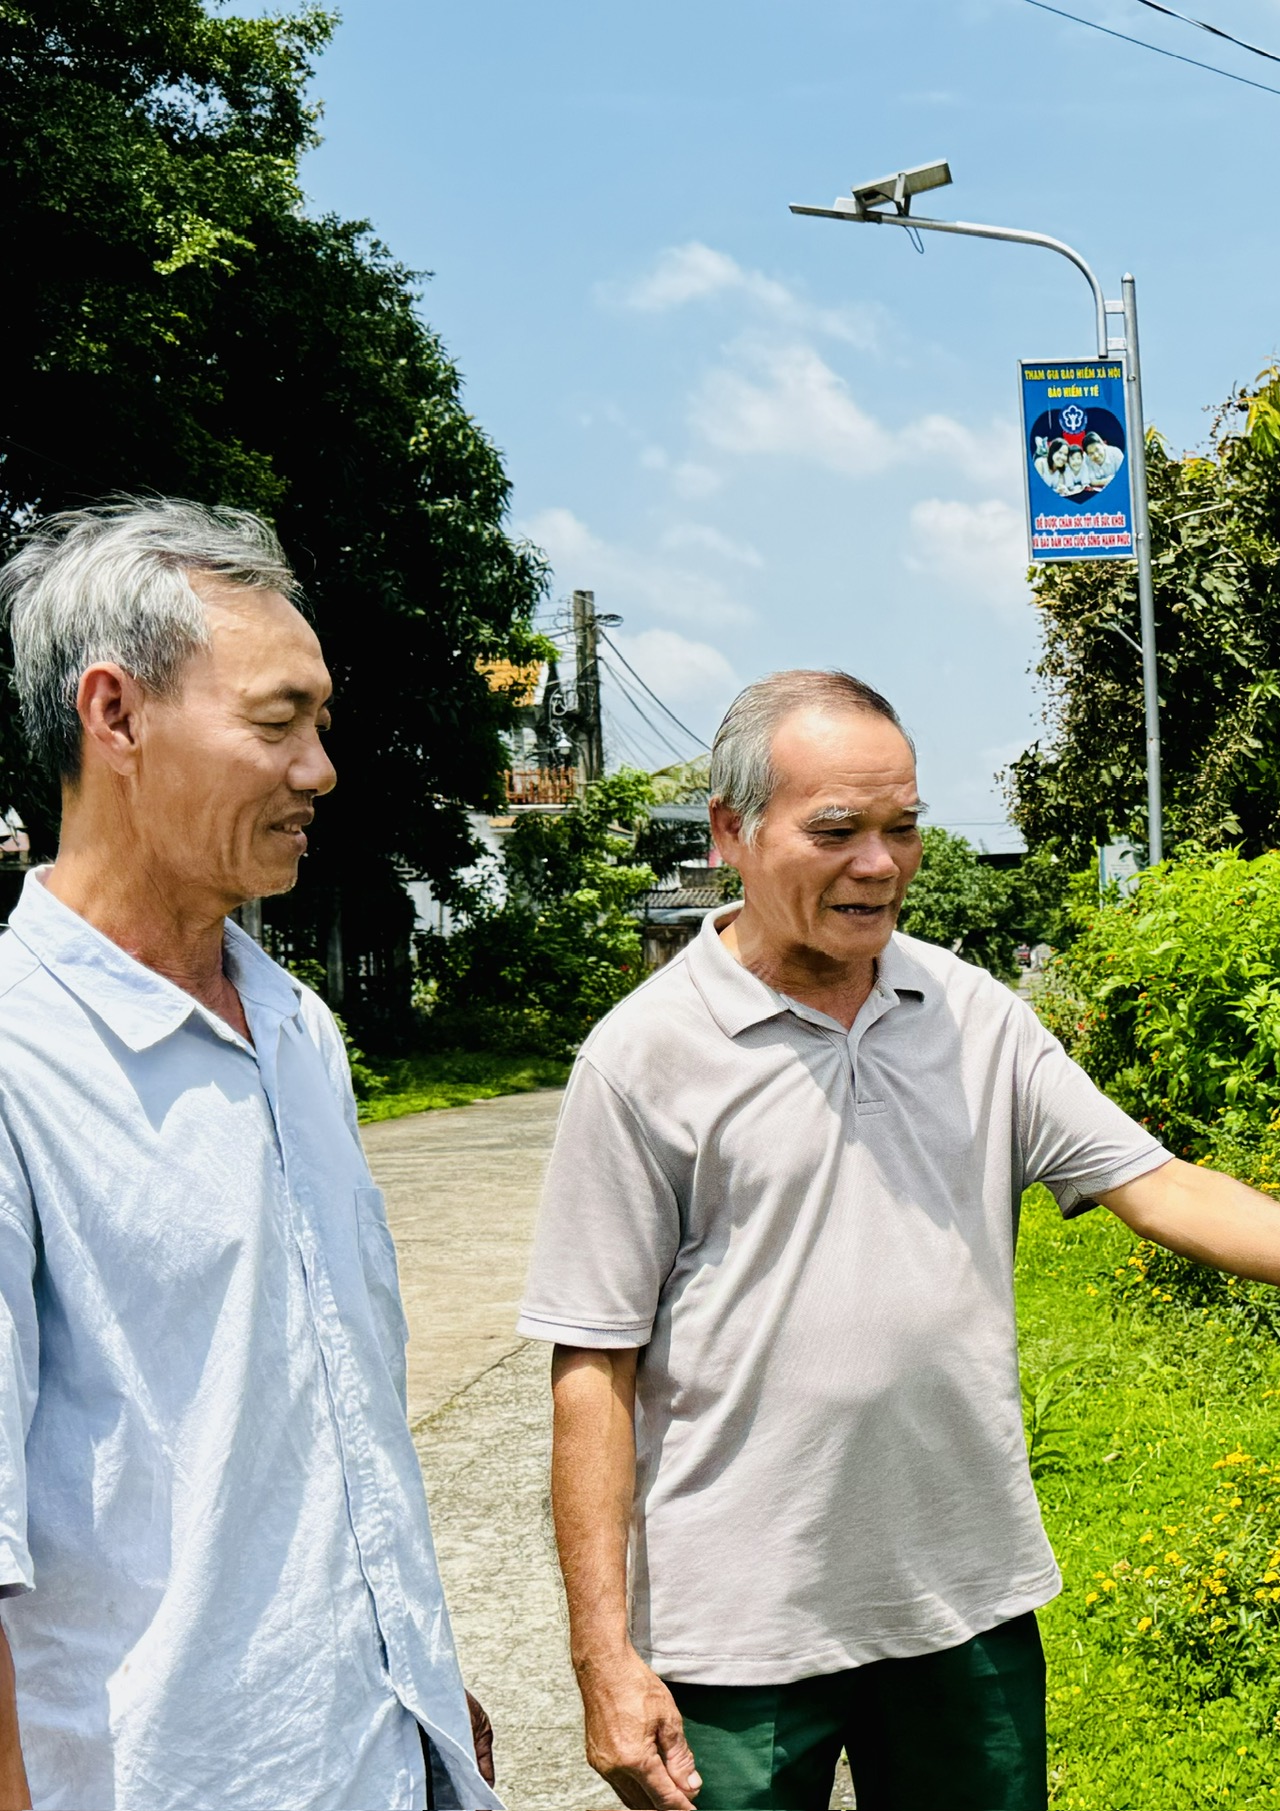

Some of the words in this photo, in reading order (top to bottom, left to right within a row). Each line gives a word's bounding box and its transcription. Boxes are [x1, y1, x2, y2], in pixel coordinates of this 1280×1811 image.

[1024, 369, 1045, 380] THAM
[1047, 369, 1059, 380] GIA
[1083, 386, 1089, 397] Y
[1090, 384, 1099, 397] TẾ
